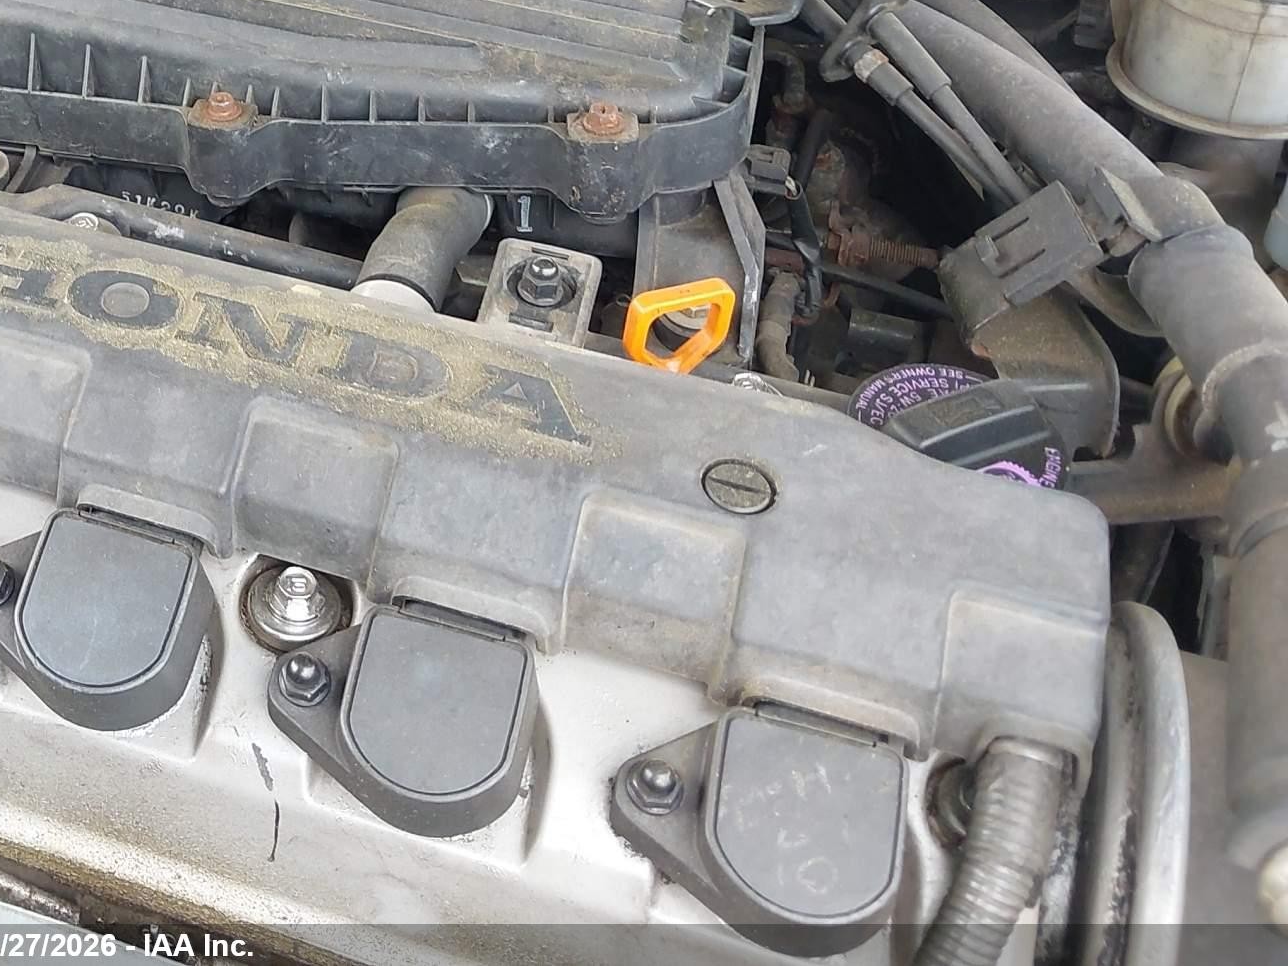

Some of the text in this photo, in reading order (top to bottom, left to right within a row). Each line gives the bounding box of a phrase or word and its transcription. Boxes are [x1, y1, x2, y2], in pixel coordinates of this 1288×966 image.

[938, 367, 964, 380] SEE
[855, 378, 887, 410] MANUAL
[888, 377, 949, 397] SERVICE
